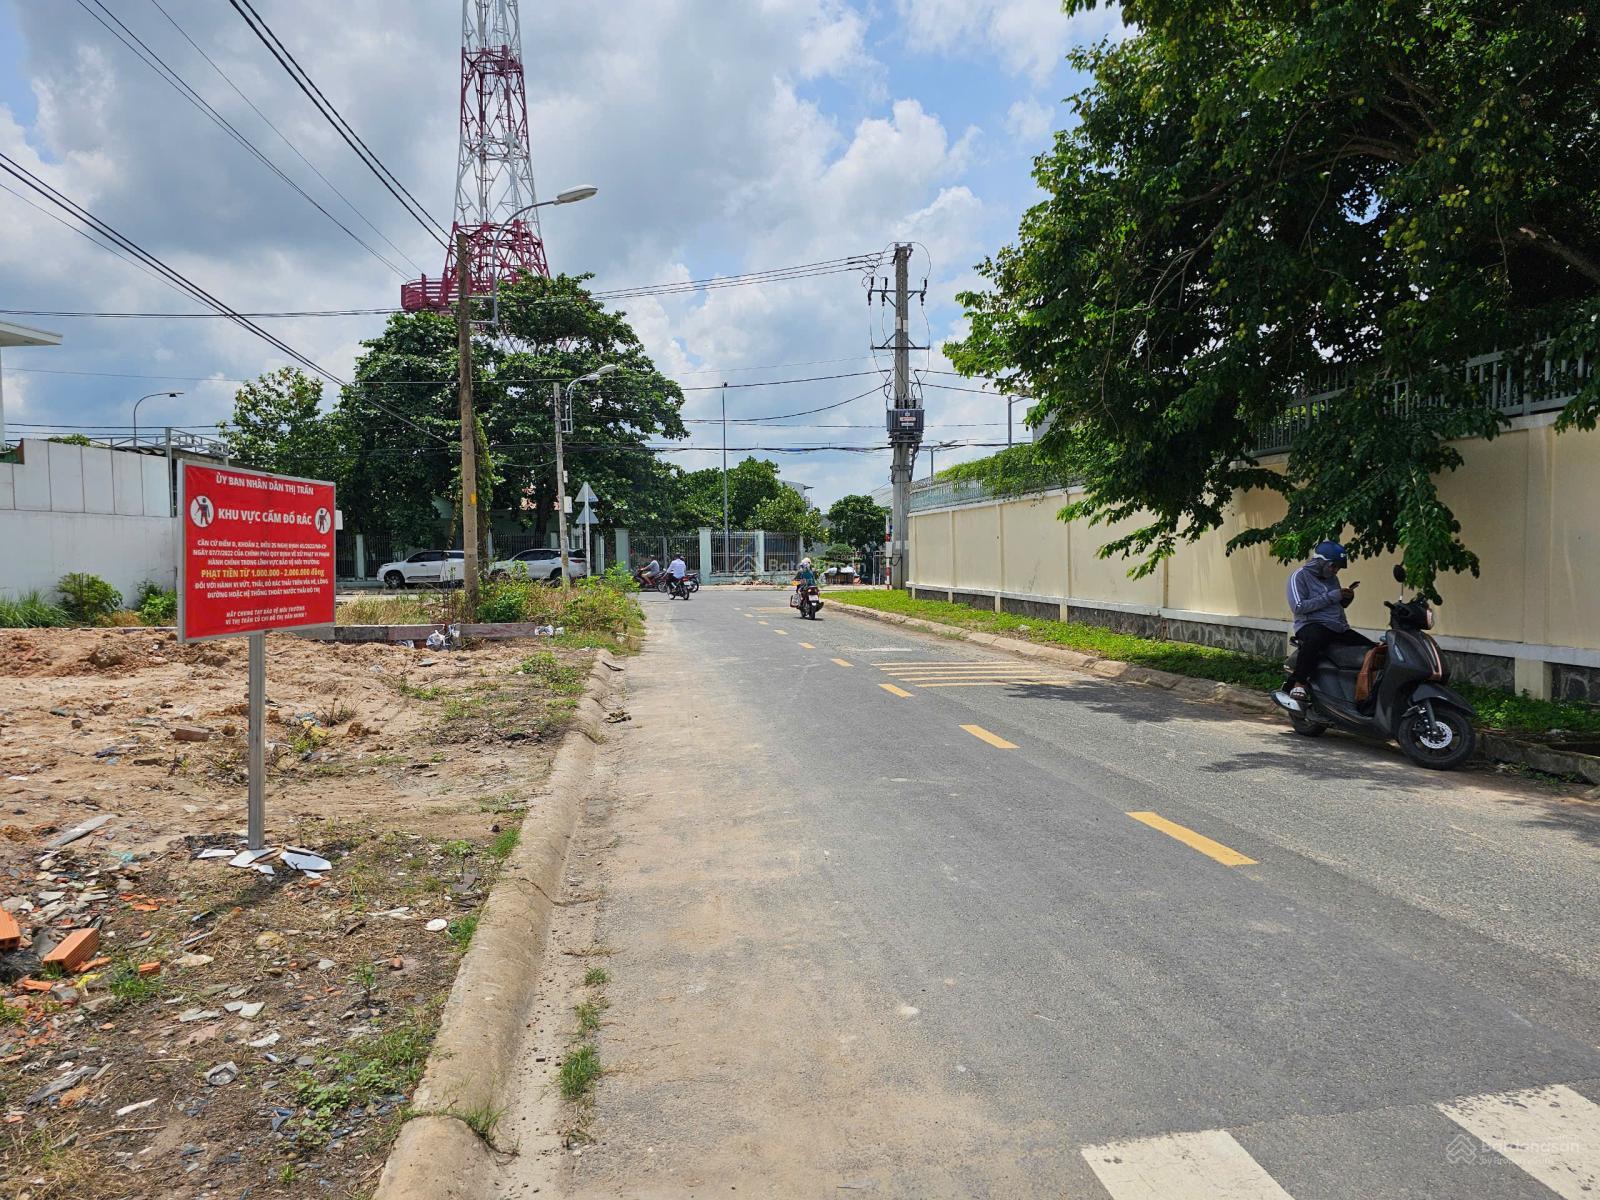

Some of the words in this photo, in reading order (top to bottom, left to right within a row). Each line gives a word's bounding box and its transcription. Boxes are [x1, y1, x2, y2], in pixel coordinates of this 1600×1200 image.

[228, 476, 245, 487] BAN
[247, 479, 268, 489] NHÂN
[269, 480, 284, 491] DÂN
[285, 484, 296, 495] THỊ
[297, 485, 314, 495] TRẤN
[218, 508, 239, 520] KHU
[241, 510, 261, 524] VỰC
[262, 510, 281, 523] CẤM
[297, 513, 312, 525] RÁC
[201, 569, 221, 580] PHẠT
[222, 567, 239, 578] TIỀN
[240, 567, 251, 577] TỪ
[251, 569, 280, 577] 1.000.000
[284, 568, 310, 577] 2.000.000
[311, 567, 325, 577] đồng
